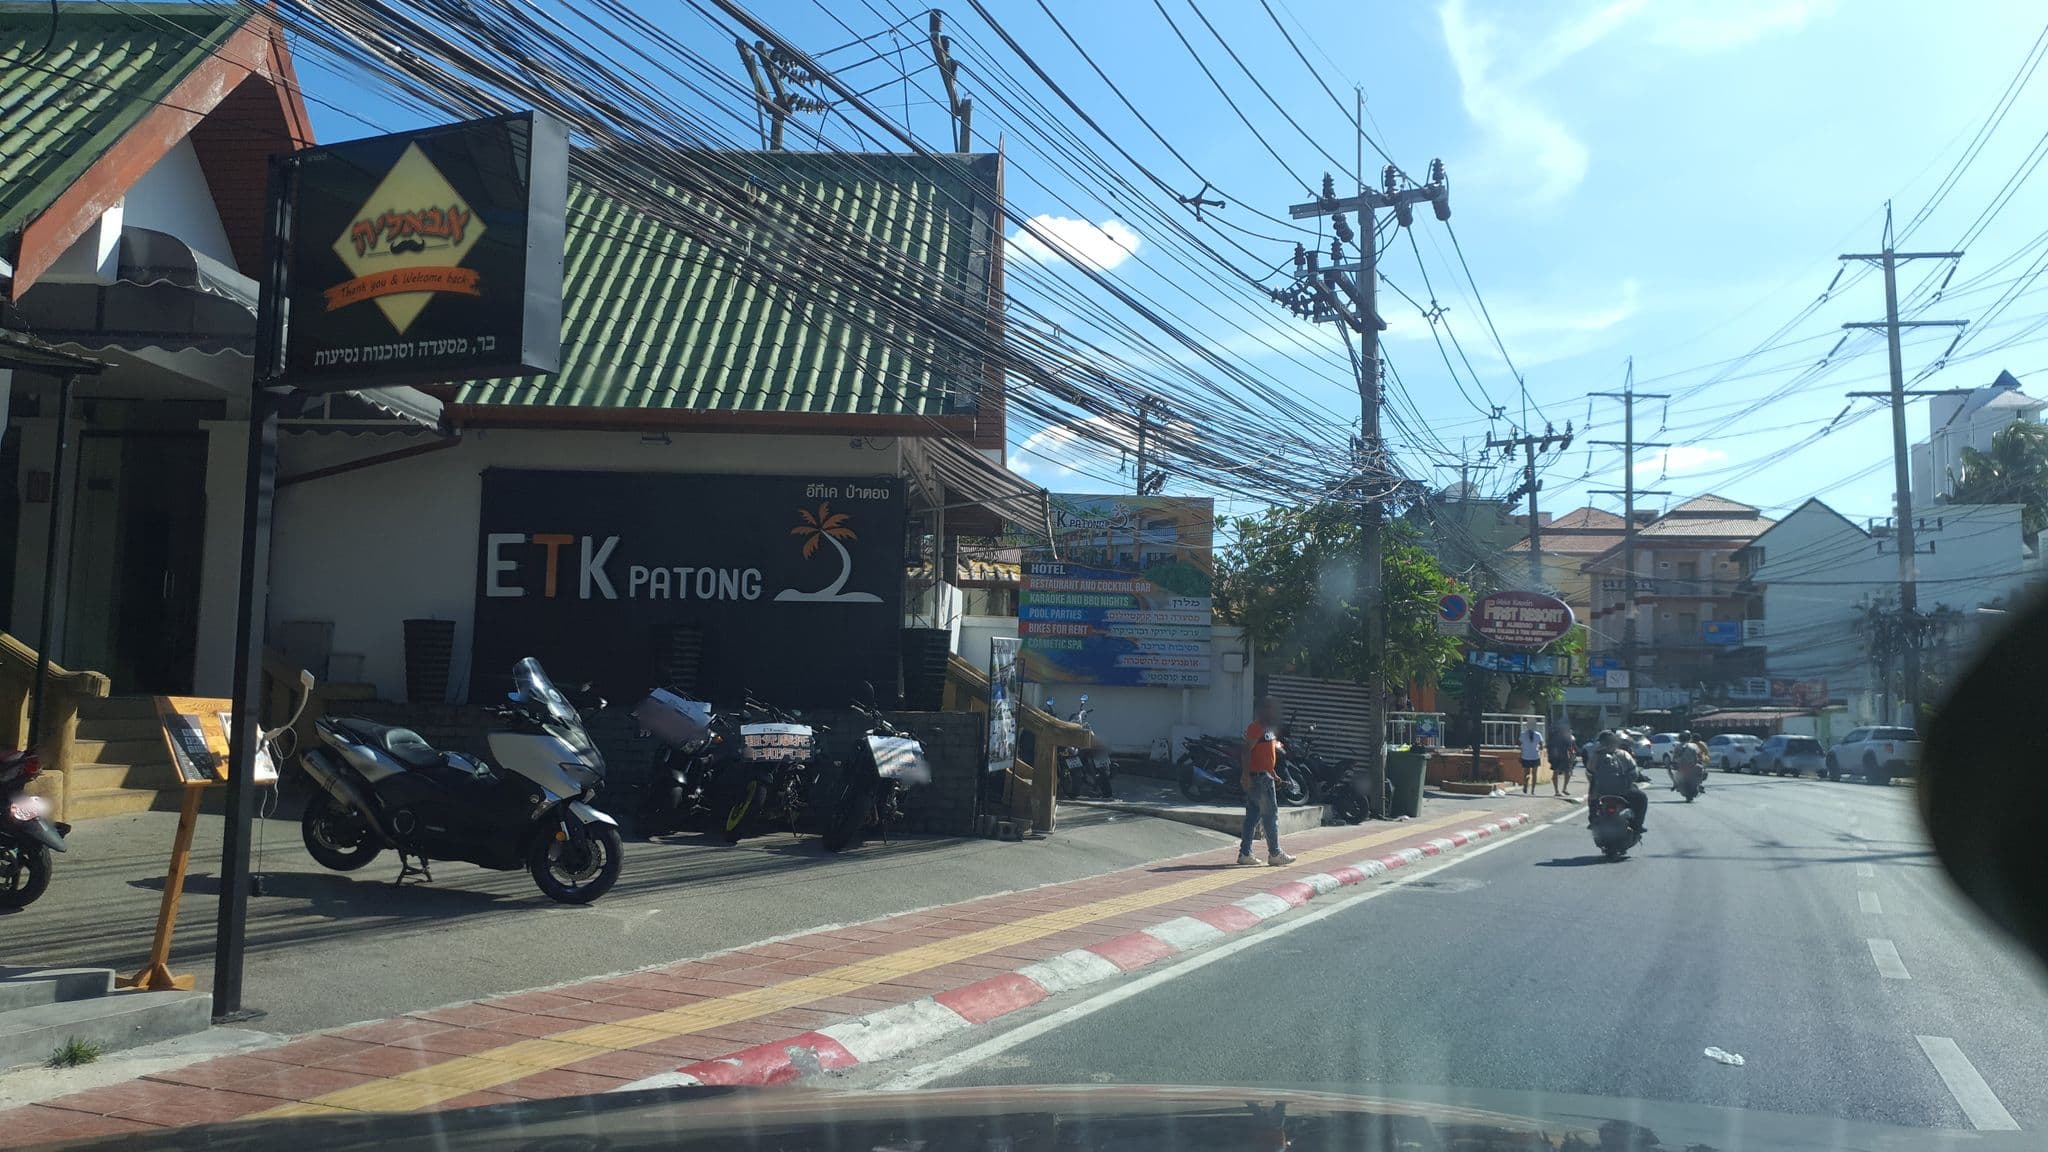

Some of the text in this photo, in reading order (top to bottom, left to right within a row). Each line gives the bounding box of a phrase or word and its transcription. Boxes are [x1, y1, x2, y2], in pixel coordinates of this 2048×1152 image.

[341, 271, 467, 298] Thank you & Welcome back
[314, 336, 496, 366] בר, מסעדה וסוכנות נסיעות
[486, 533, 762, 601] ETK PATONG
[1031, 564, 1066, 575] HOTEL
[1030, 578, 1151, 593] RESTAURANT AND COCKTAIL BAR
[1030, 593, 1129, 607] KARAOKE AND BBQ NIGHTS
[1171, 598, 1200, 608] מלון
[1029, 608, 1082, 620] POOL PARTIES
[1029, 623, 1088, 635] BIKES FOR RENT
[1028, 638, 1083, 650] COSMETIC SPA
